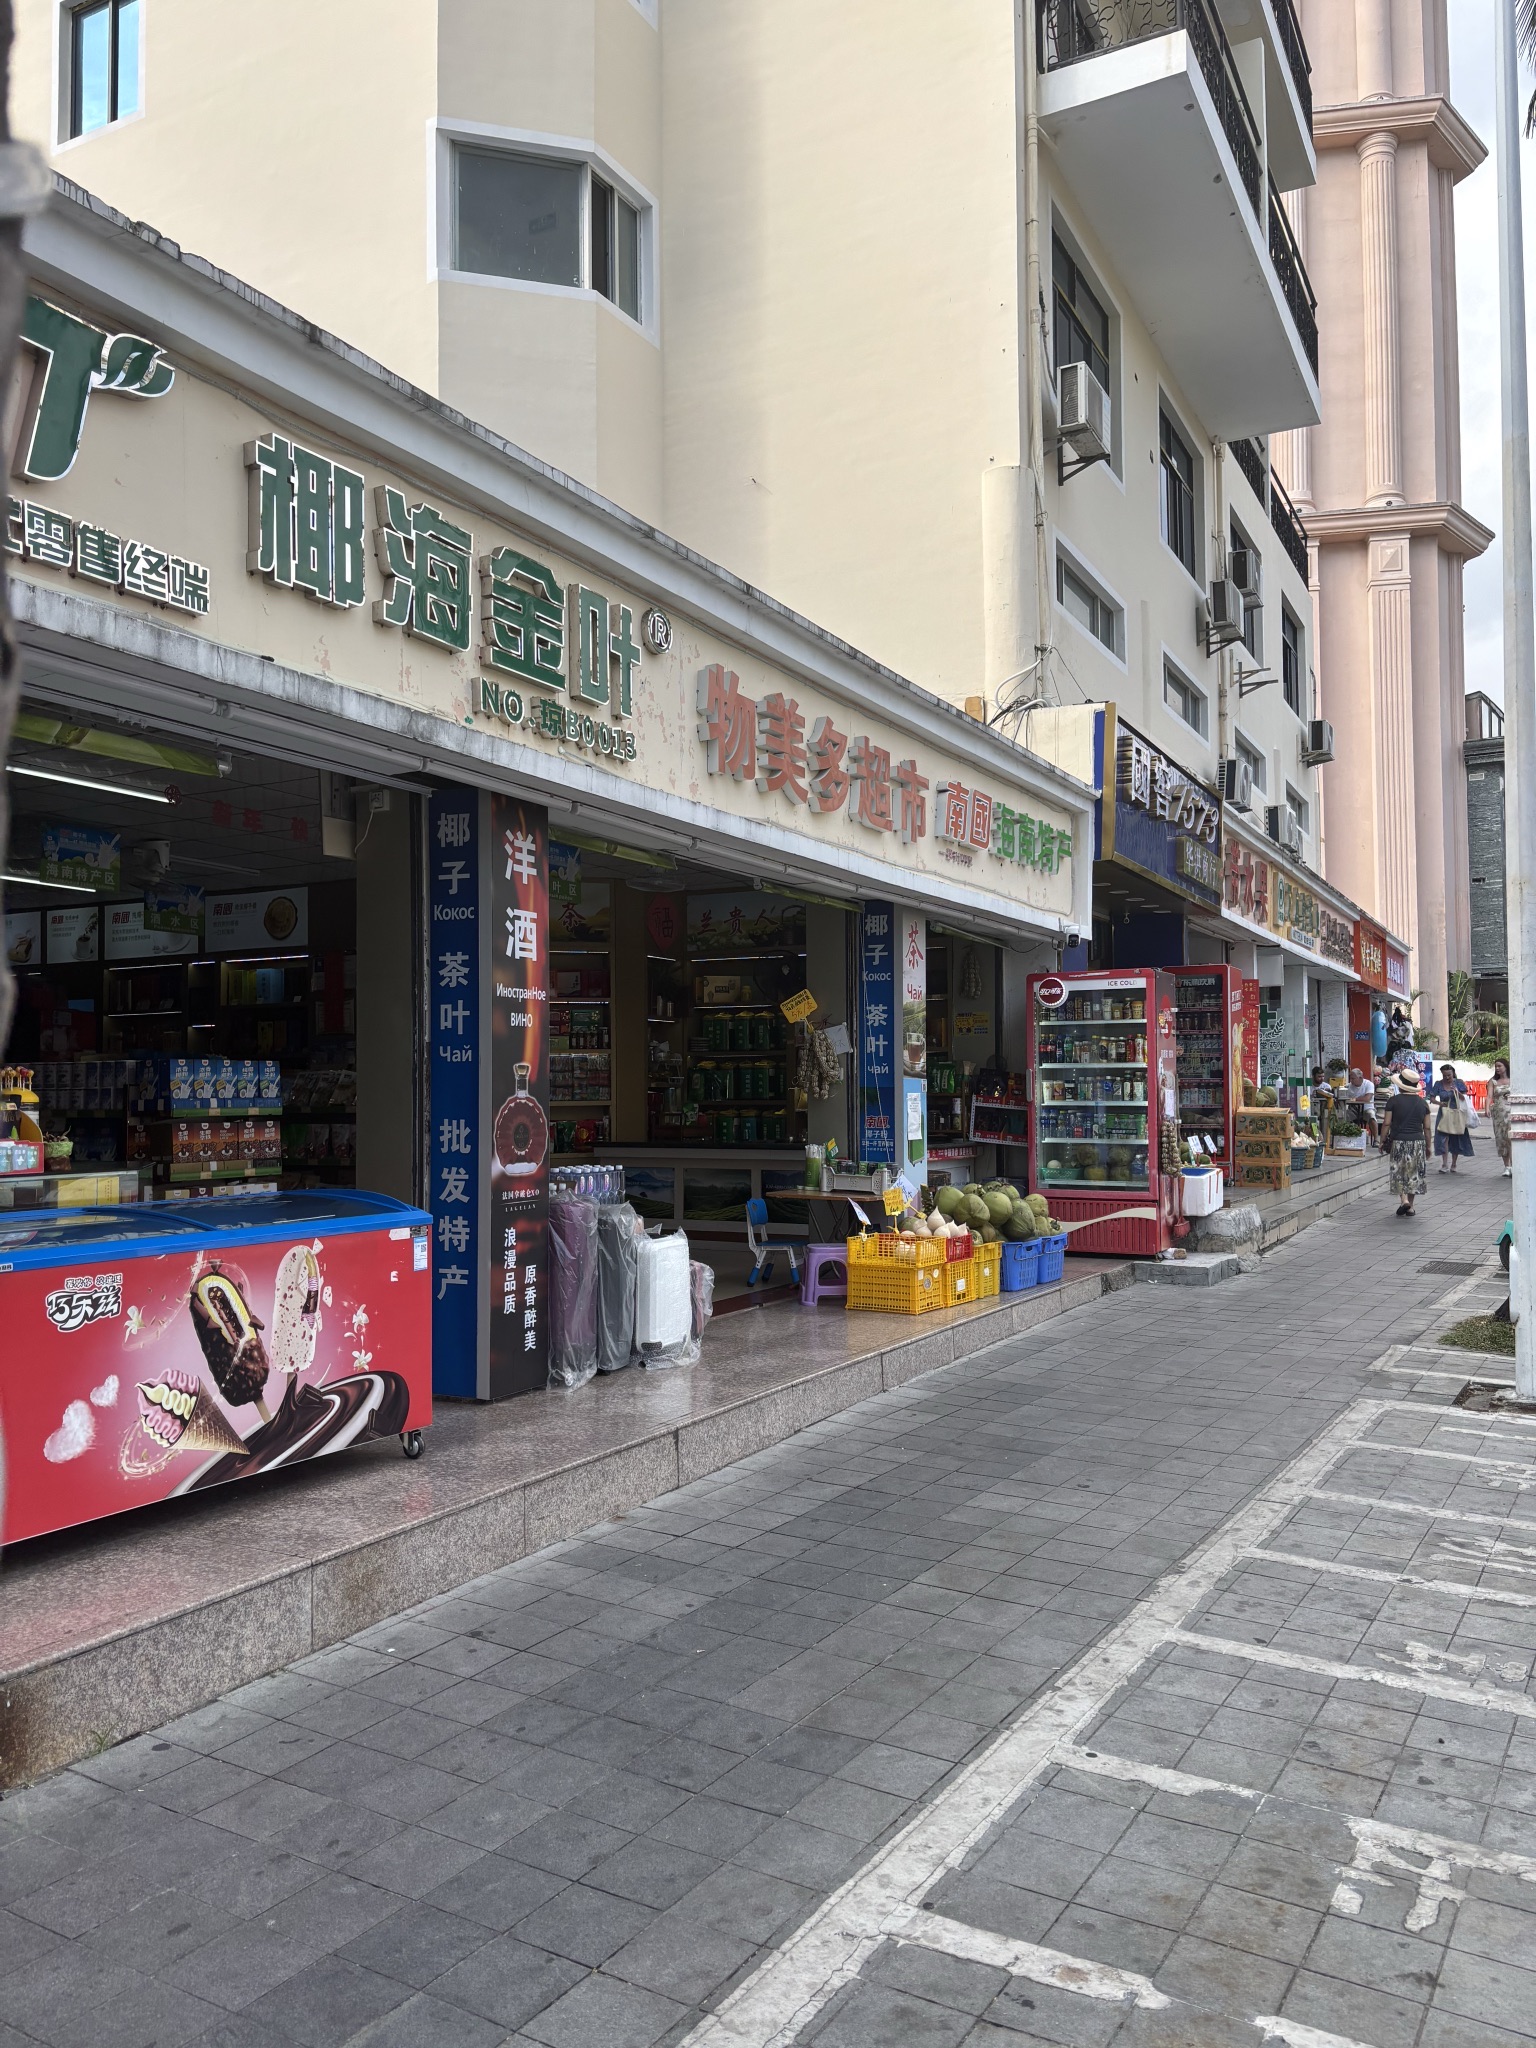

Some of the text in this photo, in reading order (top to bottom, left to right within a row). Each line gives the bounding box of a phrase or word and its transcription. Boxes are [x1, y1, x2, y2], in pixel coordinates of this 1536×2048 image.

[248, 432, 641, 718] 椰海金叶
[697, 663, 930, 843] 物美多超市
[437, 813, 470, 895] 椰子
[989, 801, 1072, 875] 海南特产
[46, 862, 116, 886] 海南特产区
[504, 829, 538, 962] 洋酒
[150, 912, 200, 930] 酒水区
[434, 904, 474, 921] Кокос
[697, 905, 779, 936] 兰贵人
[865, 914, 888, 966] 椰子
[905, 920, 924, 970] 茶
[438, 951, 471, 1035] 茶叶
[862, 971, 892, 981] Кокос
[906, 981, 923, 1001] Чай
[439, 1045, 472, 1062] Чай
[866, 1003, 889, 1057] 茶叶
[437, 1119, 471, 1300] 批发特产
[503, 1227, 517, 1315] 浪漫品质
[46, 1287, 121, 1331] 巧乐兹
[524, 1263, 537, 1352] 原香醉美
